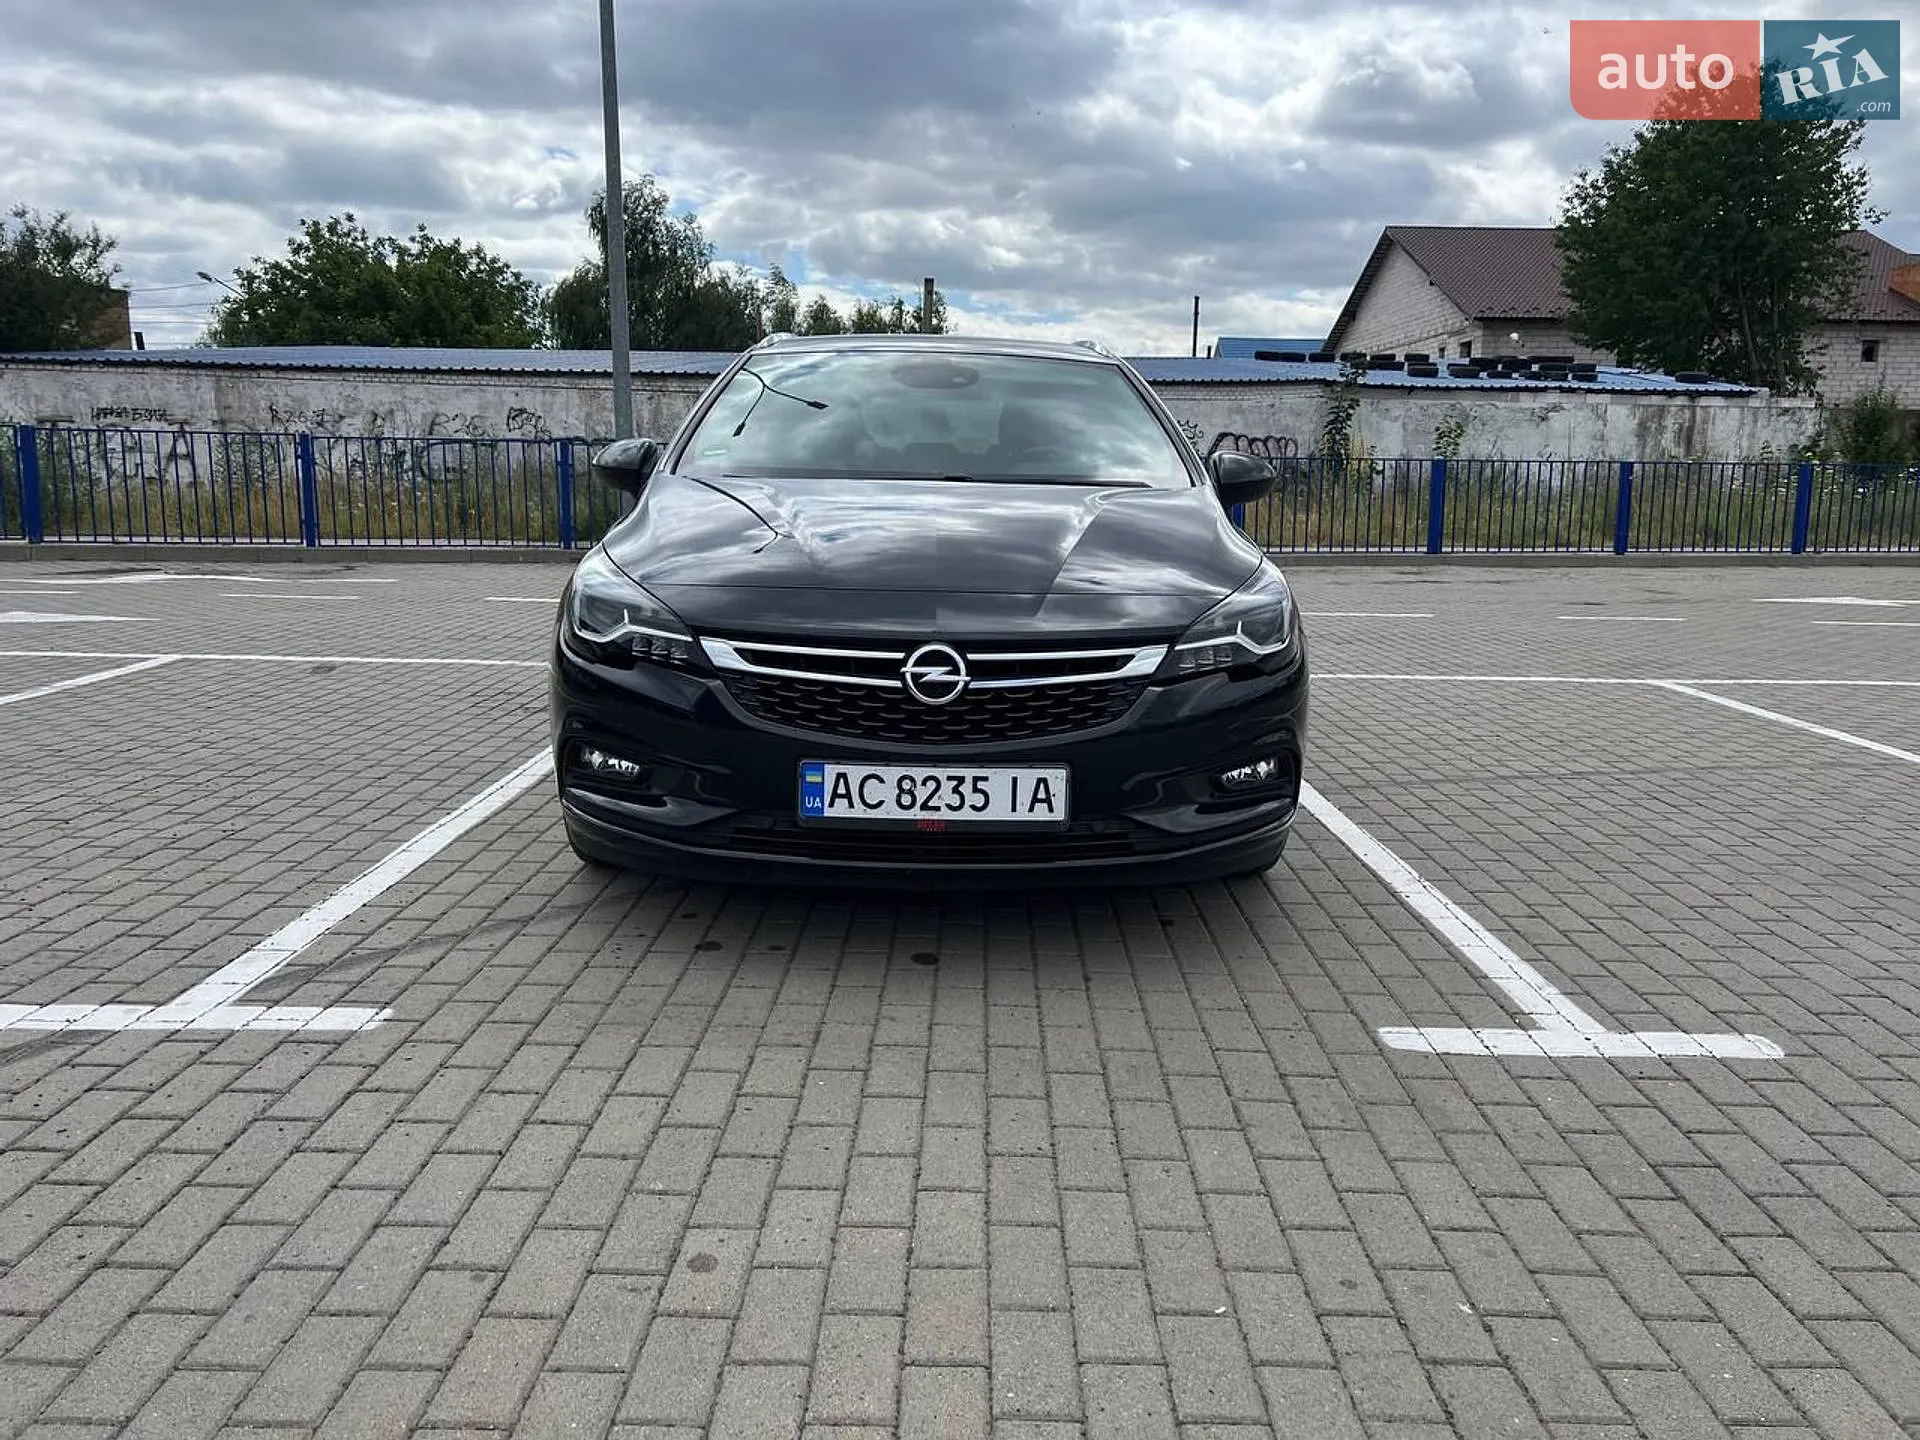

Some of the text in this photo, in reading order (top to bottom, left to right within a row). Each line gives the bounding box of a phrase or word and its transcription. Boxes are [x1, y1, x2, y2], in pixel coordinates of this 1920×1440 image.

[805, 796, 822, 808] UA
[828, 772, 1054, 813] AC 8235 IA
